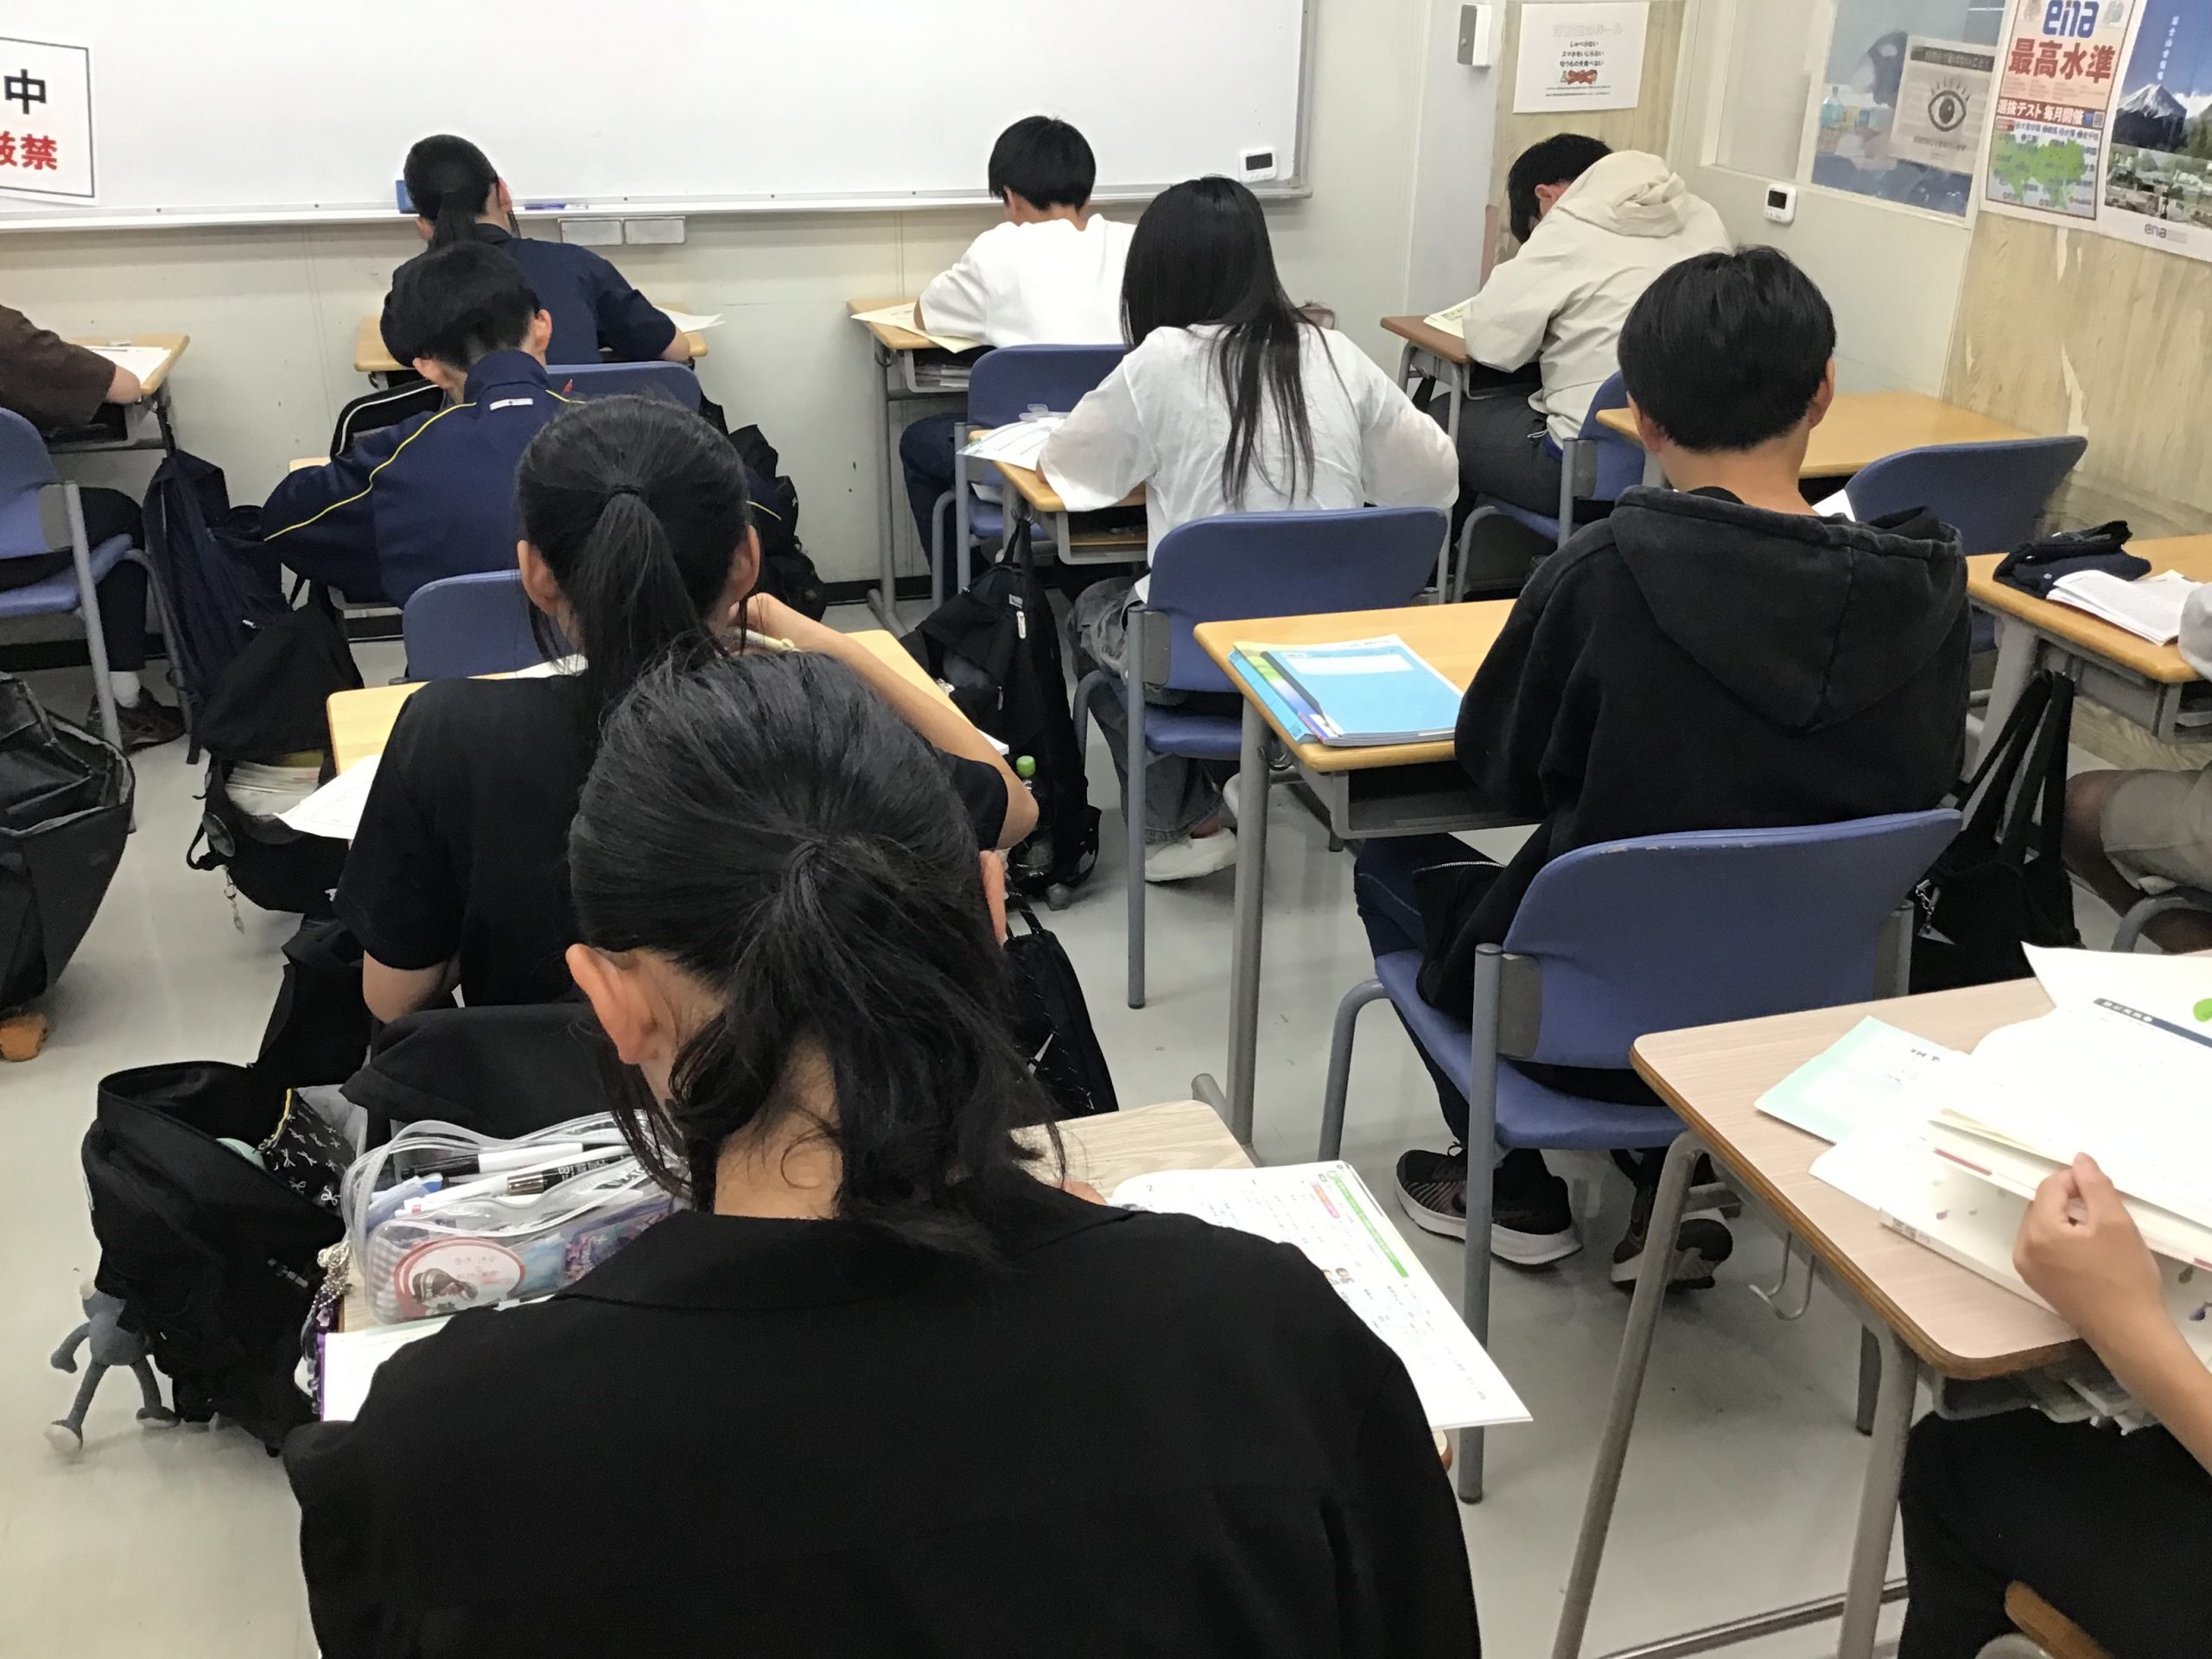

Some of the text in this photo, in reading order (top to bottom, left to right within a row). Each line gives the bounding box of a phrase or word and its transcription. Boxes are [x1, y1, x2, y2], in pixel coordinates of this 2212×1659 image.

[2007, 37, 2115, 84] 最高水準
[3, 68, 47, 115] 中
[2144, 223, 2167, 238] ena
